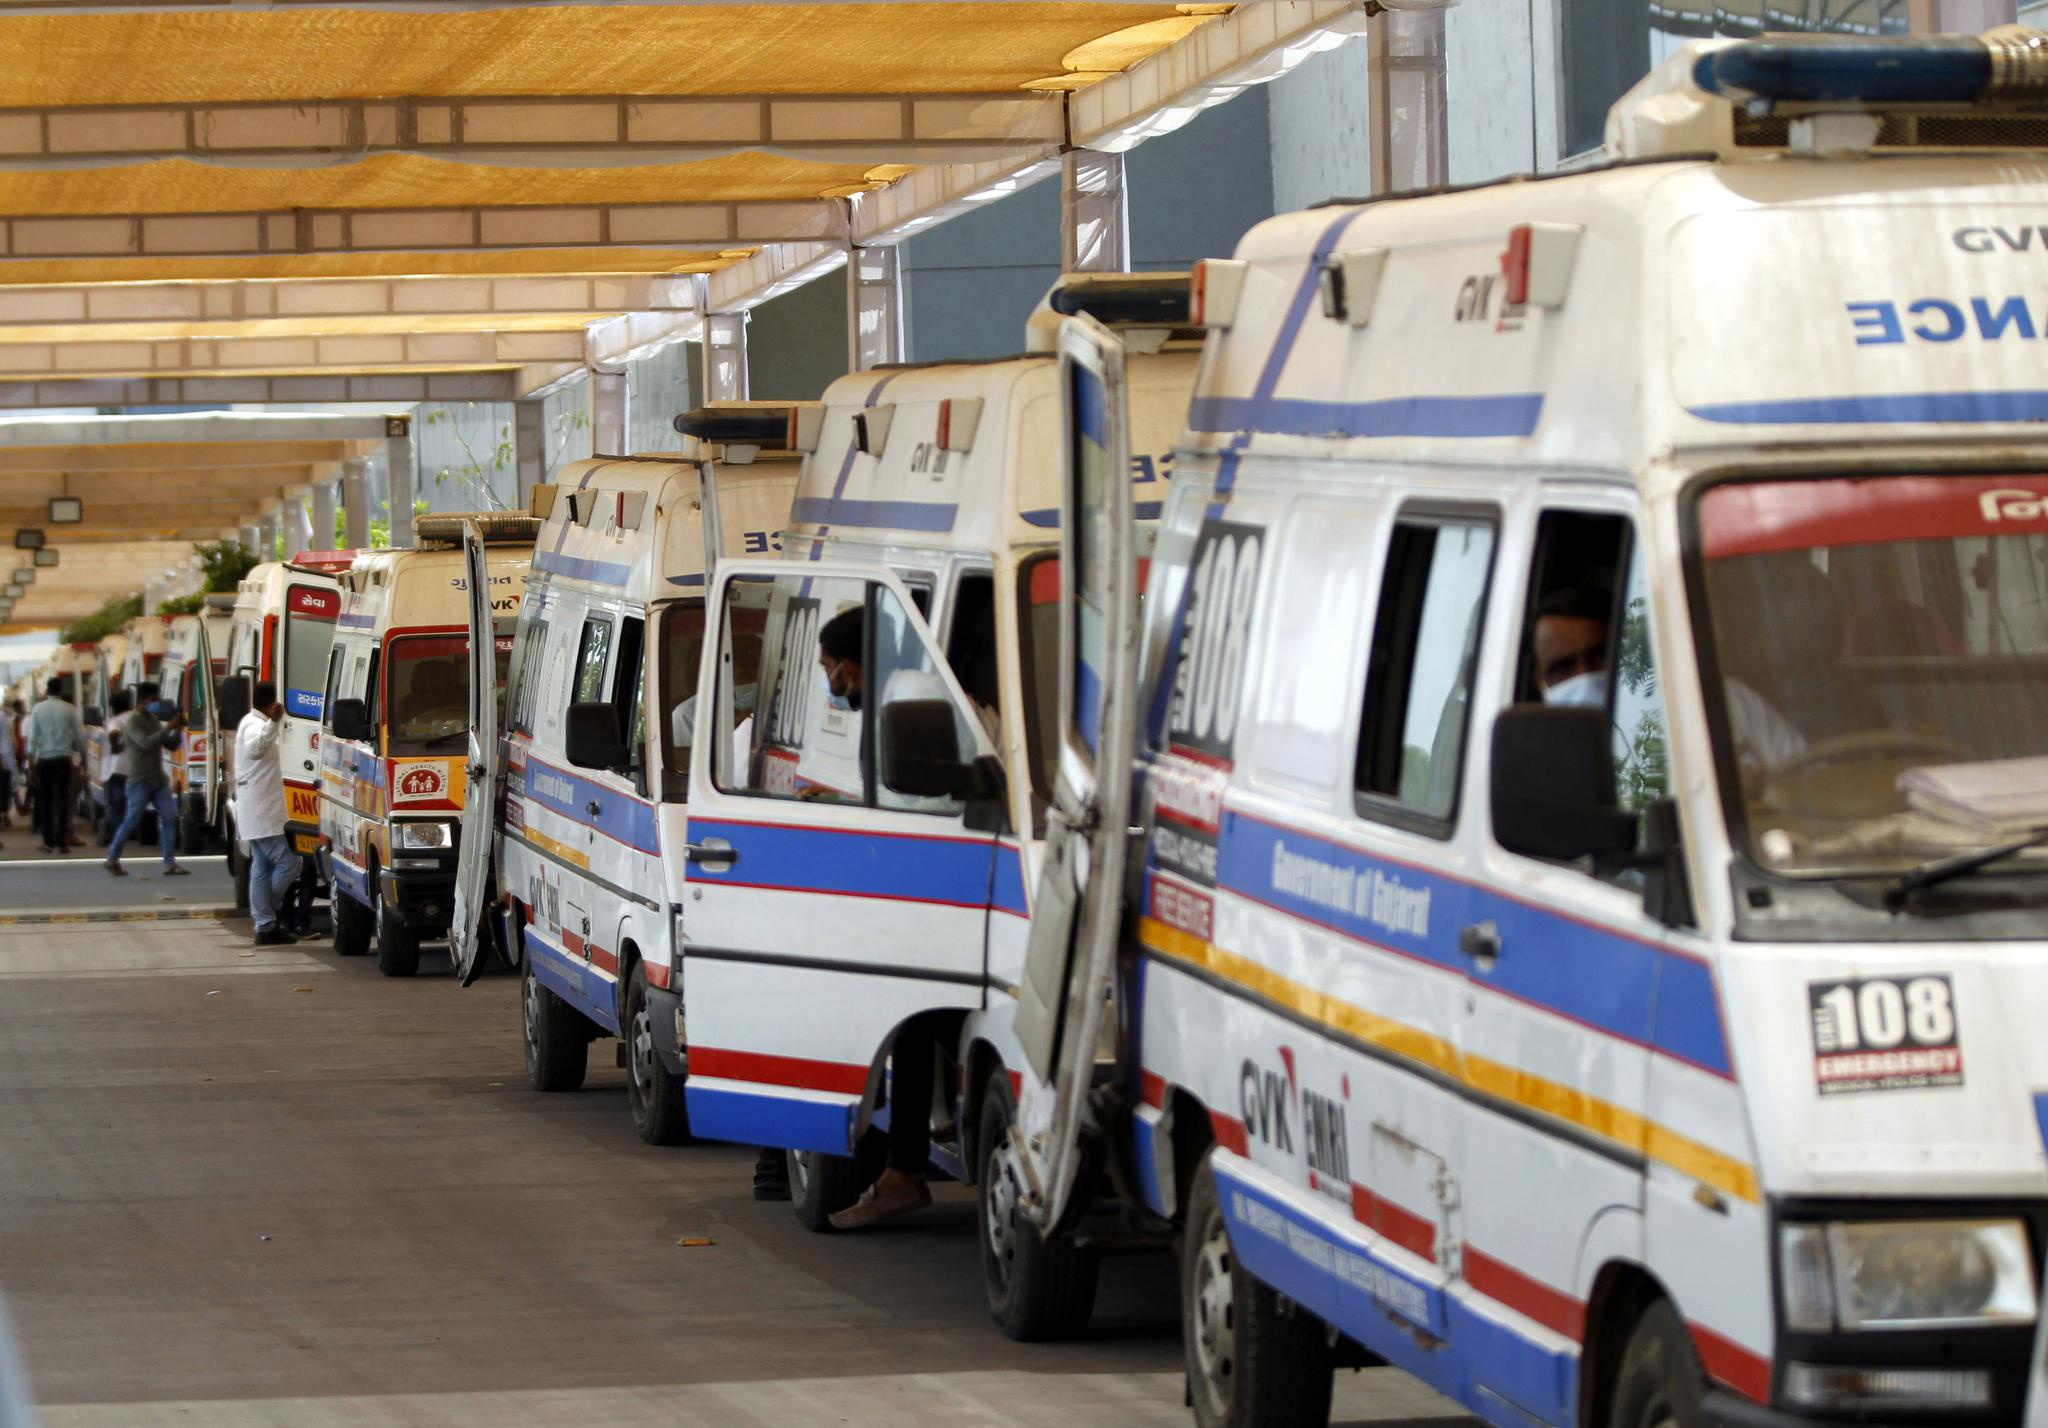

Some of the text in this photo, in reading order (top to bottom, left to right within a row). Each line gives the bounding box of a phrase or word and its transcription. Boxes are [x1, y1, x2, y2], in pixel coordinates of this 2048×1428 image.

[1952, 225, 2048, 252] GV
[490, 599, 514, 611] VK
[1272, 839, 1356, 913] Government
[1371, 869, 1431, 937] Gujarat
[1821, 977, 1955, 1049] 108
[1817, 1050, 1960, 1078] EMERGENCY
[1241, 1056, 1294, 1155] GVK
